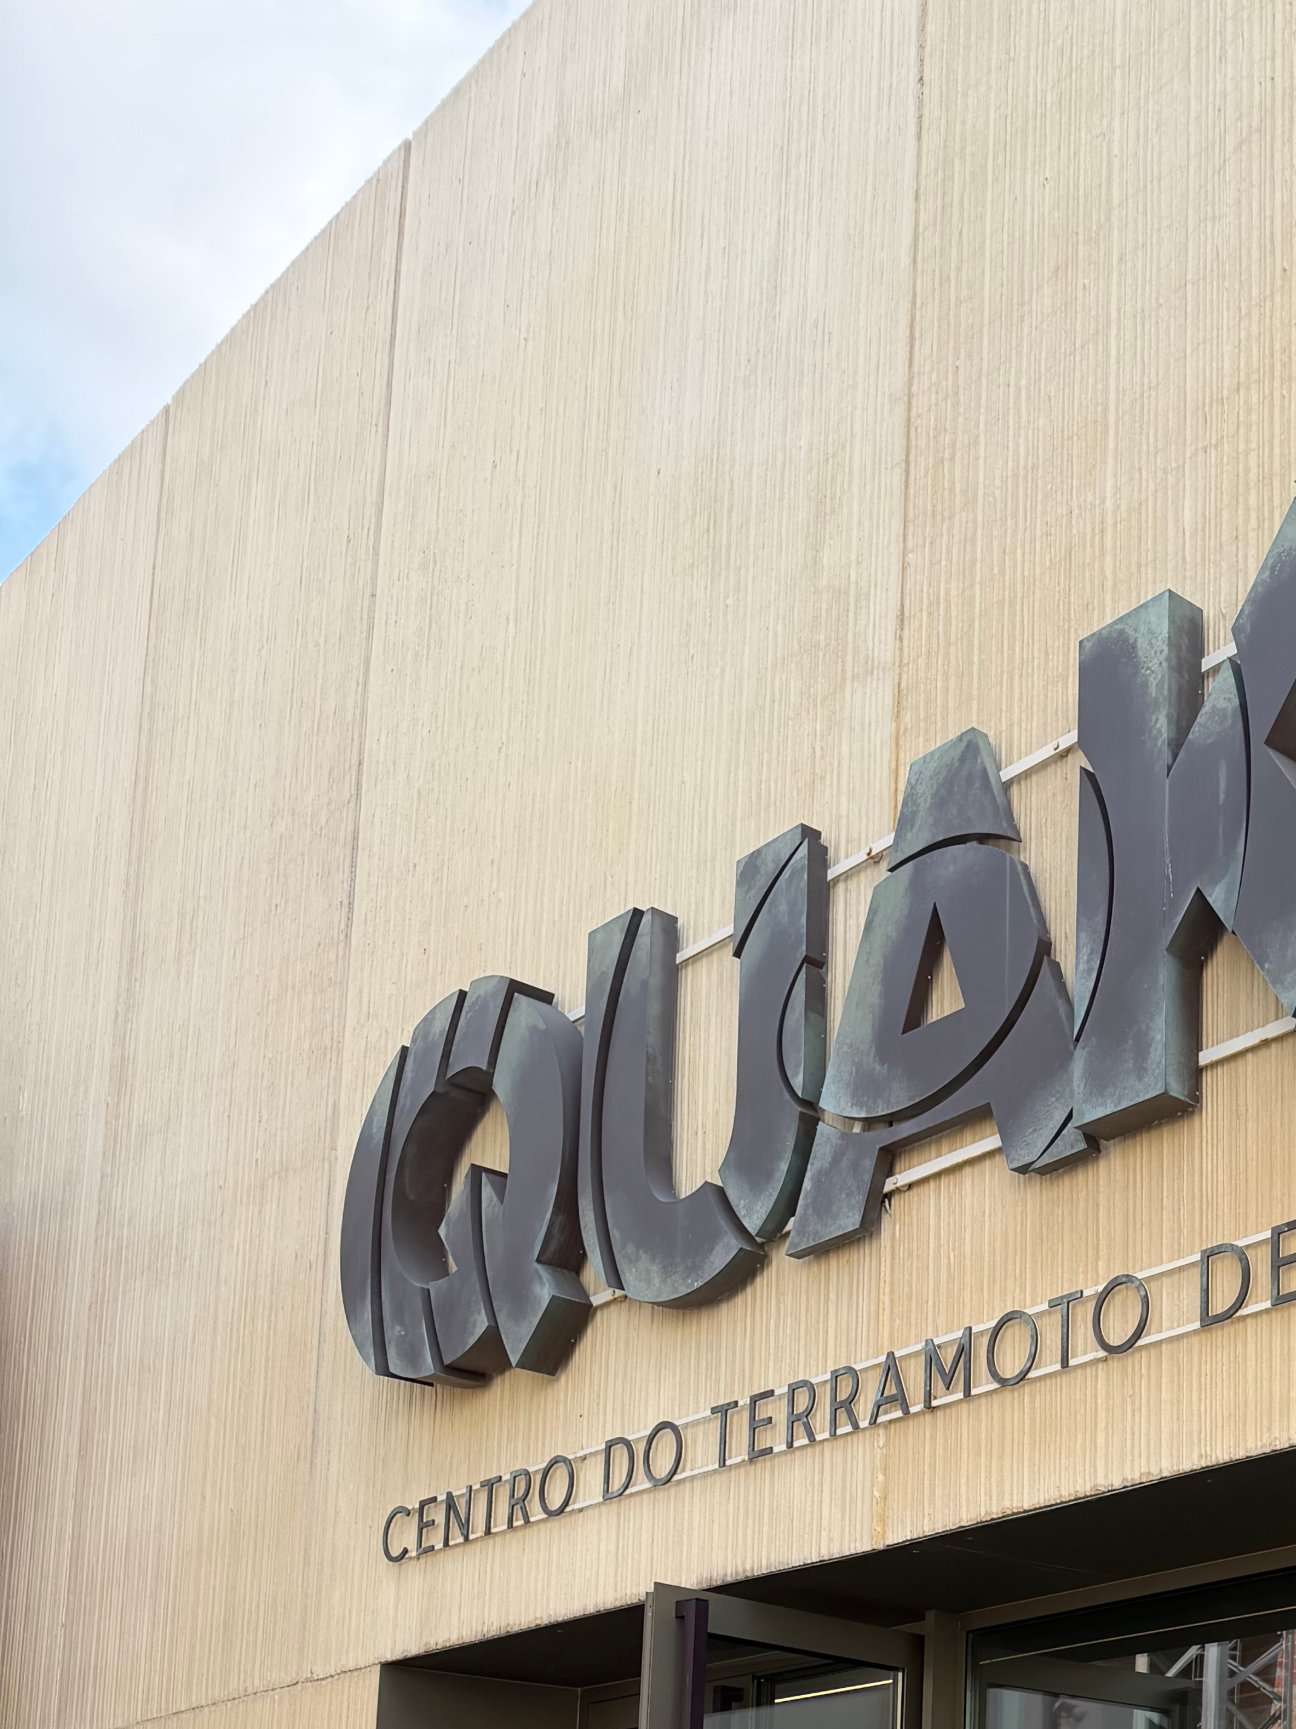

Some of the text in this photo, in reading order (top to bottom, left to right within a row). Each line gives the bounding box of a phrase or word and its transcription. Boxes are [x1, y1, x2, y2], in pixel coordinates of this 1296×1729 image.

[382, 1454, 575, 1563] CENTRO
[602, 1420, 683, 1501] DO
[710, 1273, 1151, 1469] TERRAMOTO
